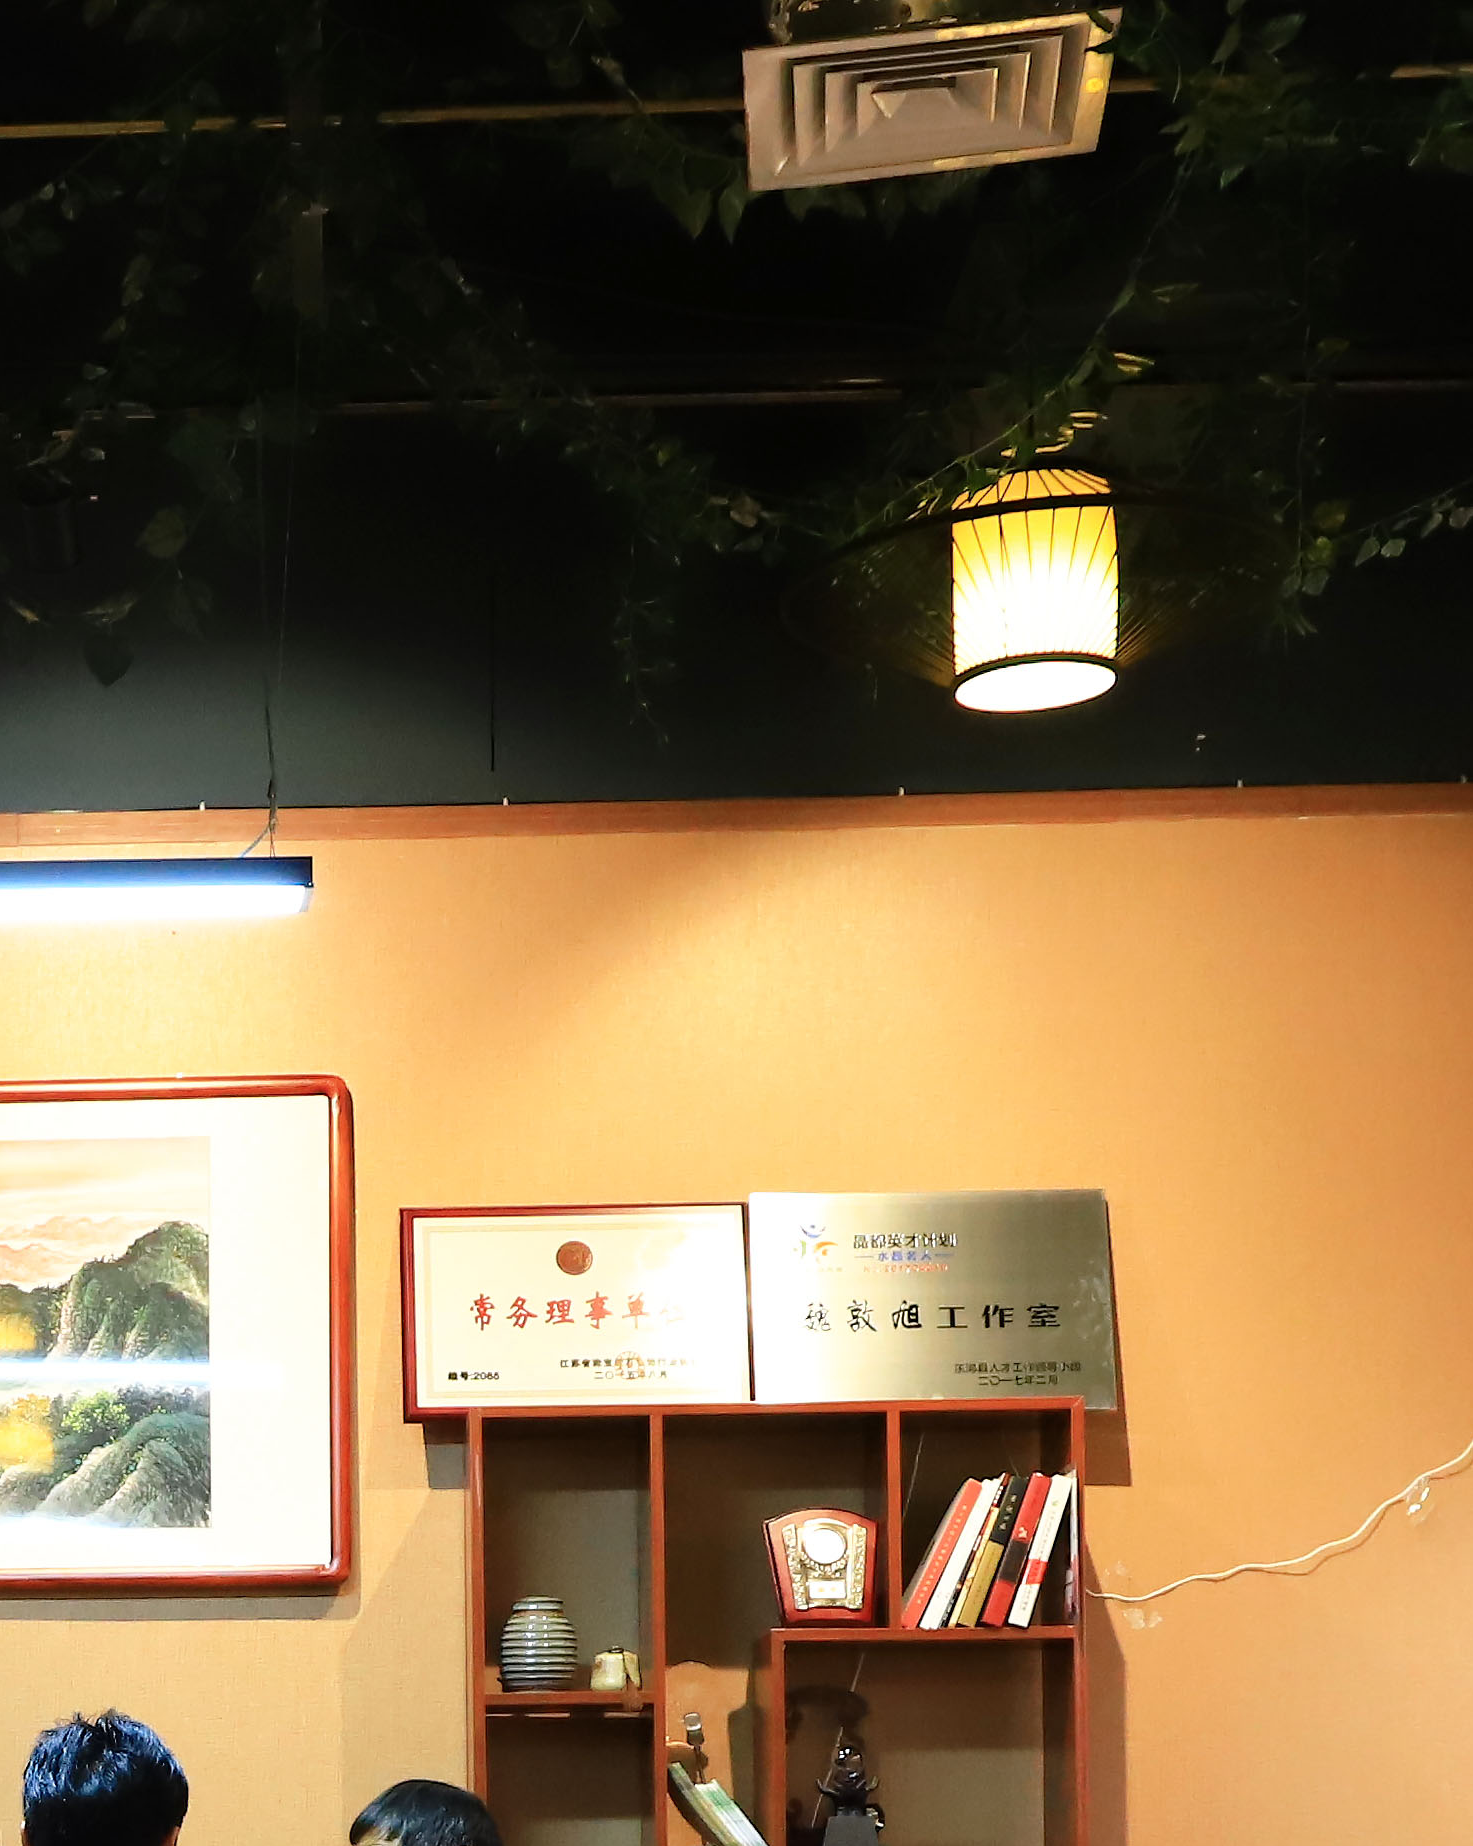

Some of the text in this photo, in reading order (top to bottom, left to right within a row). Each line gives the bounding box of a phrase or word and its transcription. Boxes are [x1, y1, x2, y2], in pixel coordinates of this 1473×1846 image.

[470, 1291, 686, 1331] 常务理事单位
[805, 1300, 1061, 1332] 魏敦旭工作室
